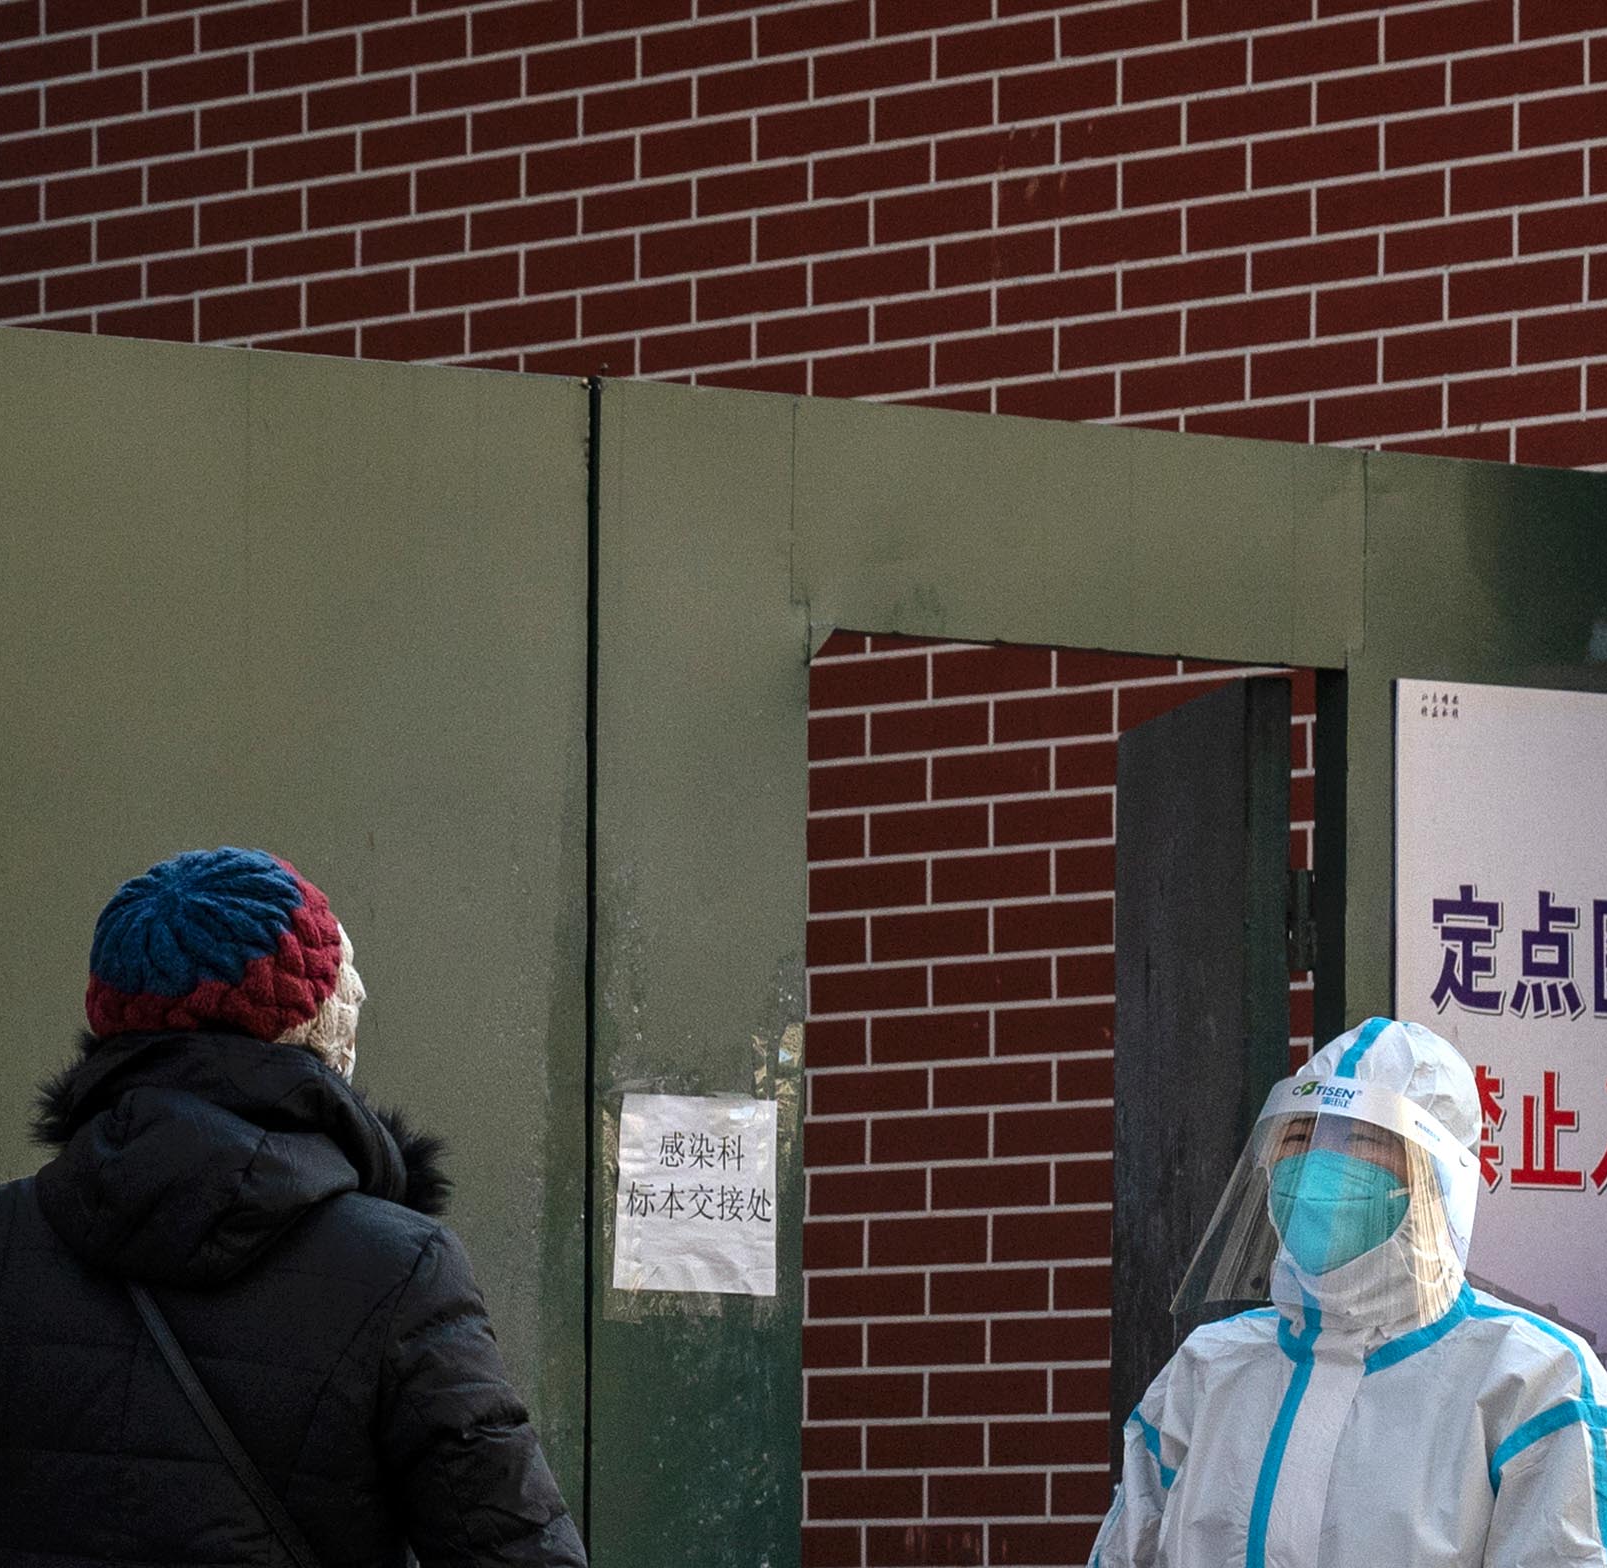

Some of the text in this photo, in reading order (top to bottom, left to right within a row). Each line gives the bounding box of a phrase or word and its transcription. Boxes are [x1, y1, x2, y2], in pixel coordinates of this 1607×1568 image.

[659, 1132, 745, 1171] 感染科
[625, 1181, 773, 1223] 标本交接处
